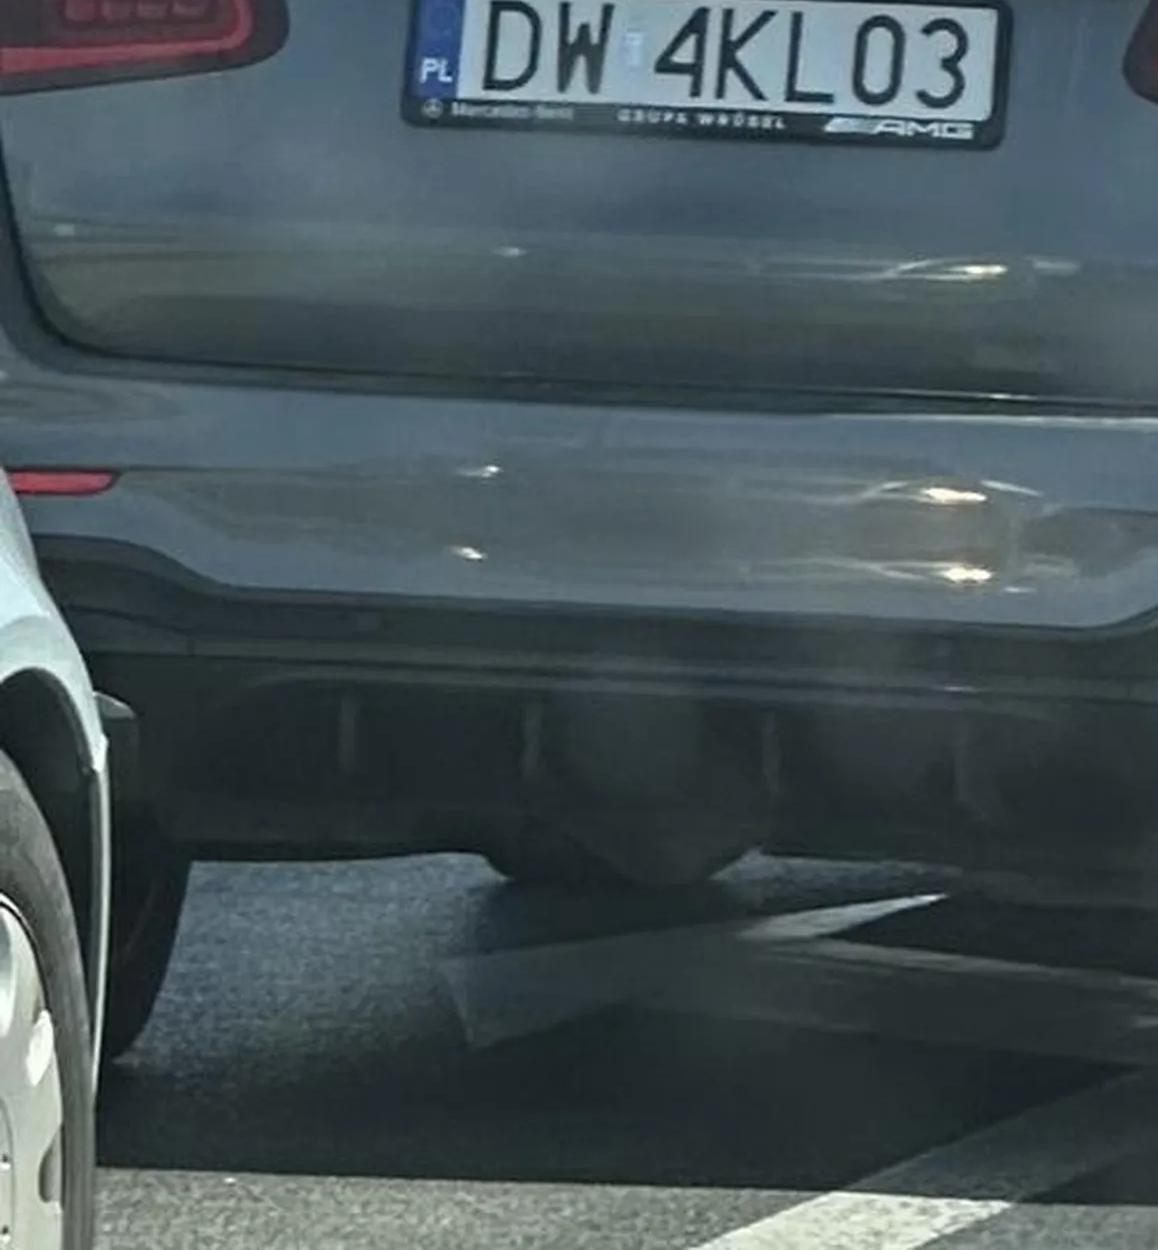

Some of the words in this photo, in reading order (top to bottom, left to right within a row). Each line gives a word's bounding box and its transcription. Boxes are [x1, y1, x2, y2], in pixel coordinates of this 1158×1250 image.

[483, 0, 616, 94] DW
[652, 6, 970, 110] 4KL03
[420, 57, 453, 83] PL
[870, 119, 974, 140] AMG
